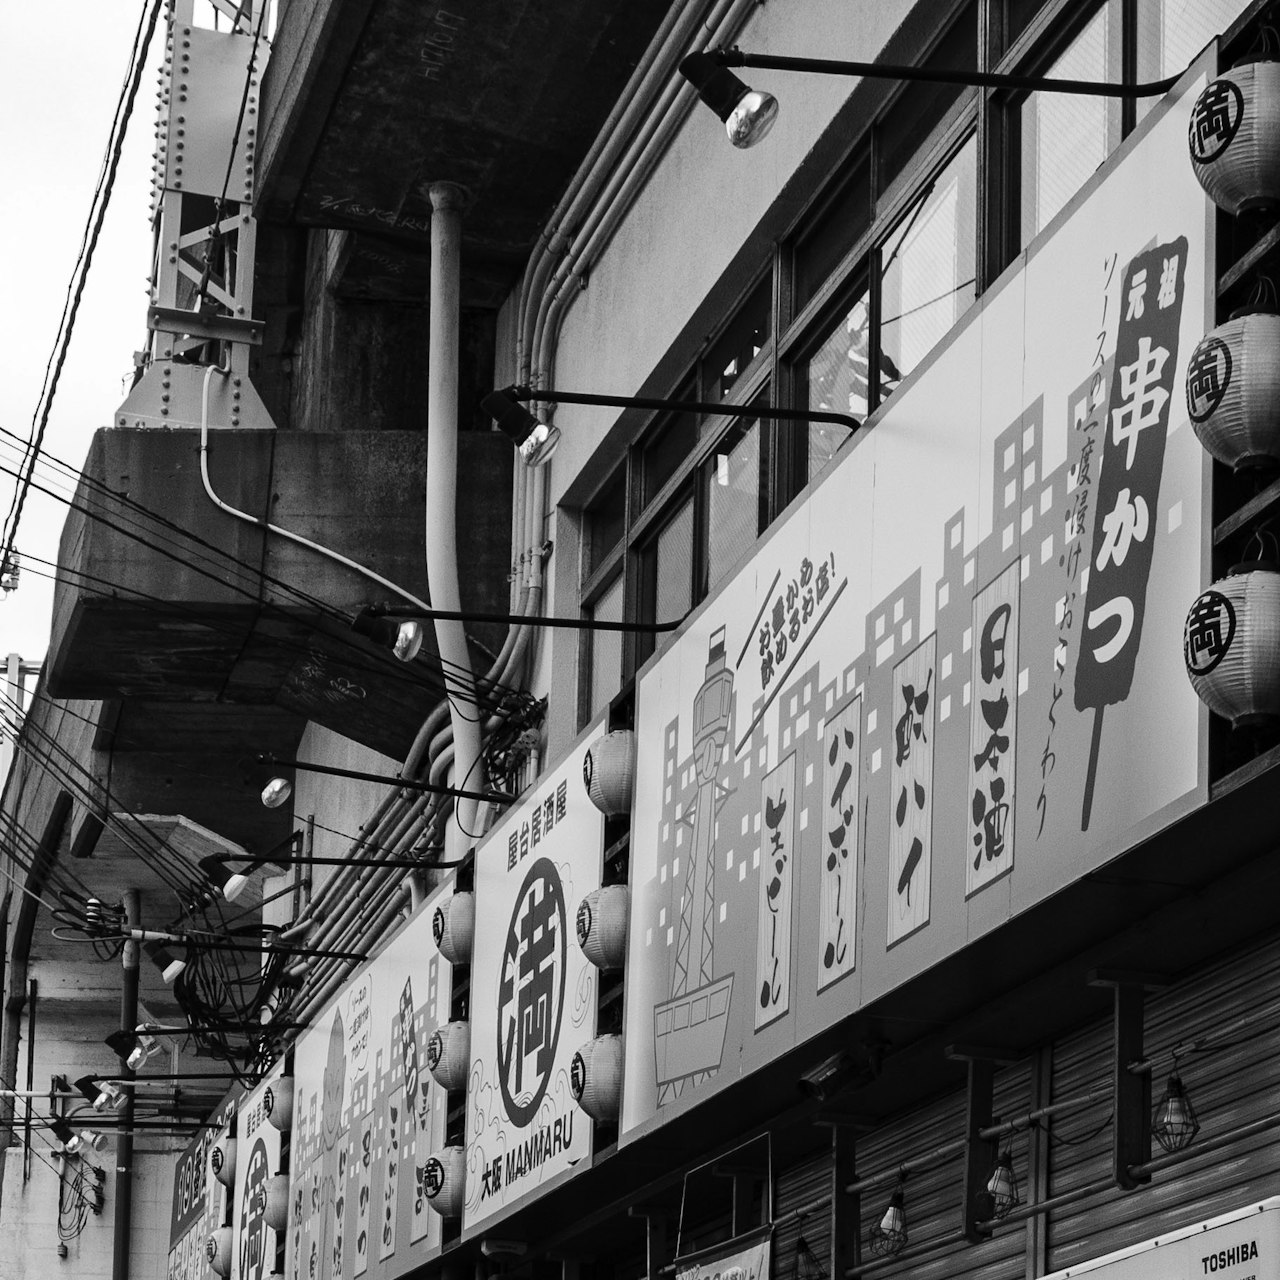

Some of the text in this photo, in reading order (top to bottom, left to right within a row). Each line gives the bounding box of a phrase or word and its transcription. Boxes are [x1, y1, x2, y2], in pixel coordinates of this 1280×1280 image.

[1124, 253, 1180, 323] 元祖
[1086, 335, 1172, 665] 串かつ
[507, 778, 568, 873] 屋台居酒屋
[820, 722, 857, 969] ハイボール
[892, 666, 930, 910] 酎ハイ
[972, 603, 1015, 872] 日本酒
[500, 868, 562, 1112] 満
[757, 797, 791, 1010] 生ビール
[481, 1154, 503, 1202] 大阪
[505, 1109, 574, 1187] MANMARU
[1202, 1240, 1259, 1275] TOSHIBA
